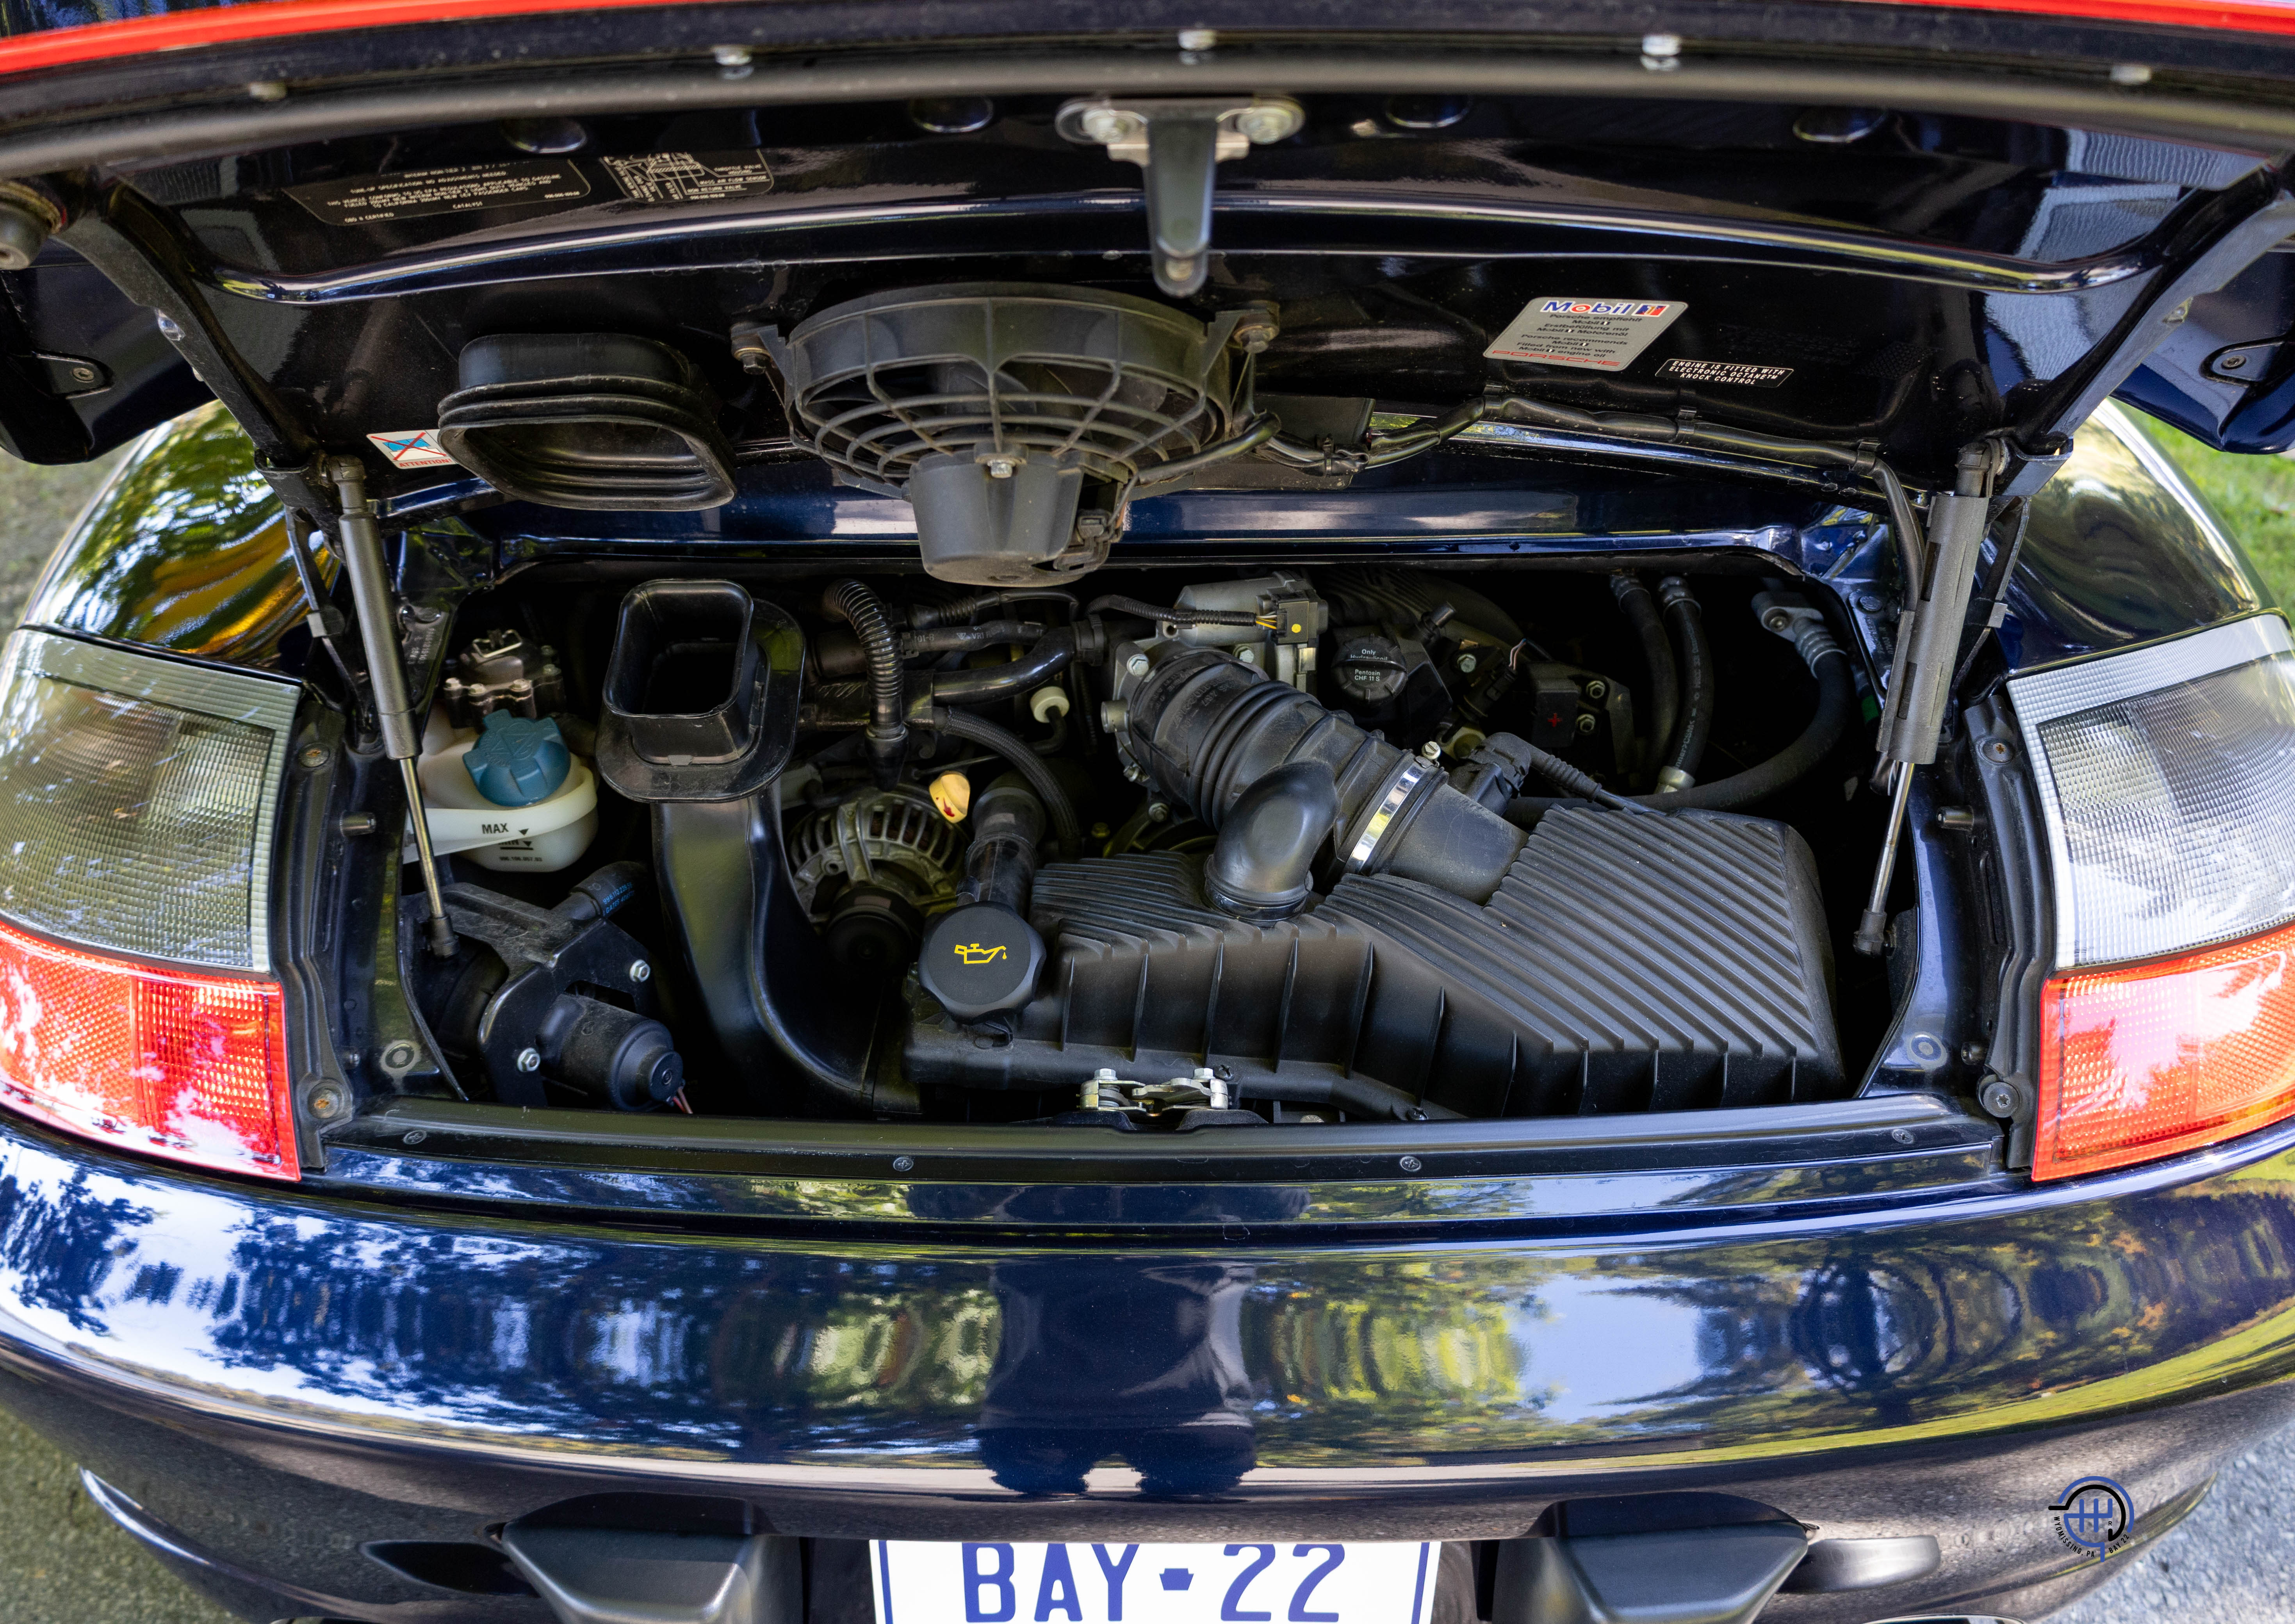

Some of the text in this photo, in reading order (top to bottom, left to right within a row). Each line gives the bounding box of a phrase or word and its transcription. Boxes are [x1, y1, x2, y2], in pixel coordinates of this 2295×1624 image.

[1541, 301, 1634, 315] Mobil
[1544, 323, 1609, 331] Erstbefüllung
[1563, 337, 1628, 345] recommends
[1492, 350, 1620, 367] PORSCHE
[1672, 361, 1707, 369] ENGINE
[1669, 366, 1727, 376] ELECTRONIC
[1714, 376, 1755, 385] CONTROL
[399, 458, 451, 468] ATTENTION!
[482, 823, 509, 834] MAX
[962, 1542, 1345, 1623] BAY 22
